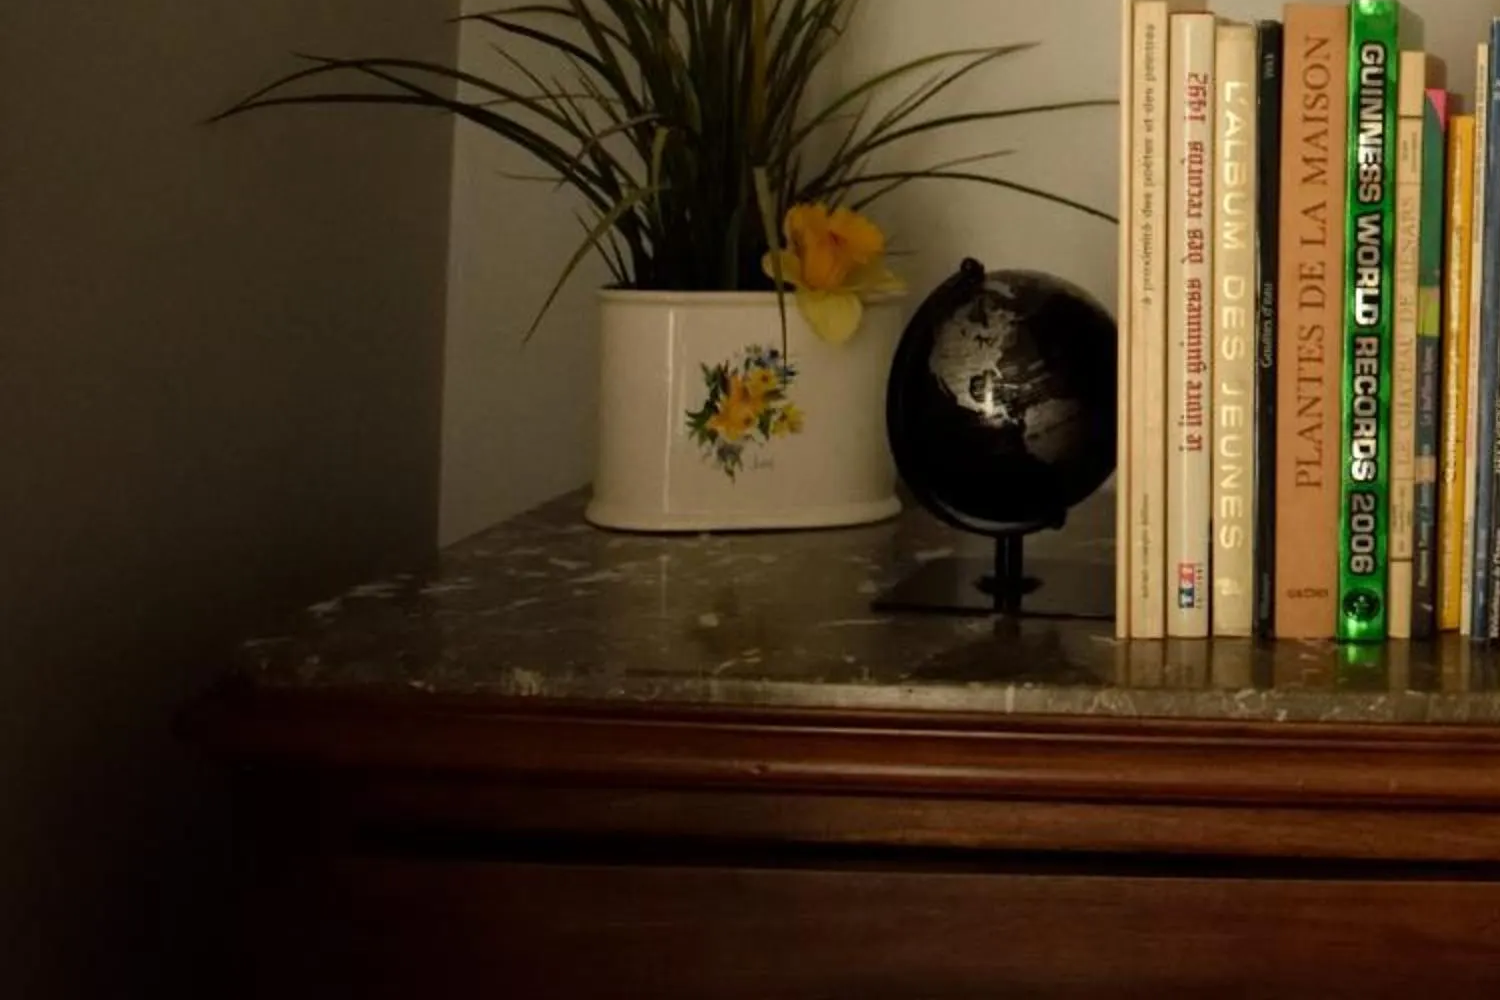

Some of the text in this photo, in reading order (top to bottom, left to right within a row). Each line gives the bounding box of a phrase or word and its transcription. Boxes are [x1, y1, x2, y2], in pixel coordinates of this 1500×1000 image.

[1180, 141, 1206, 219] records
[1179, 228, 1205, 264] des
[1294, 36, 1332, 489] PLANTES DE LA MAISON
[1180, 276, 1208, 375] guinness
[1218, 80, 1249, 551] L'ALBUM DES JEUNES
[1348, 41, 1386, 575] GUINNESS WORLD RECORDS 2006
[1177, 379, 1204, 427] livre
[1177, 562, 1195, 609] TF1
